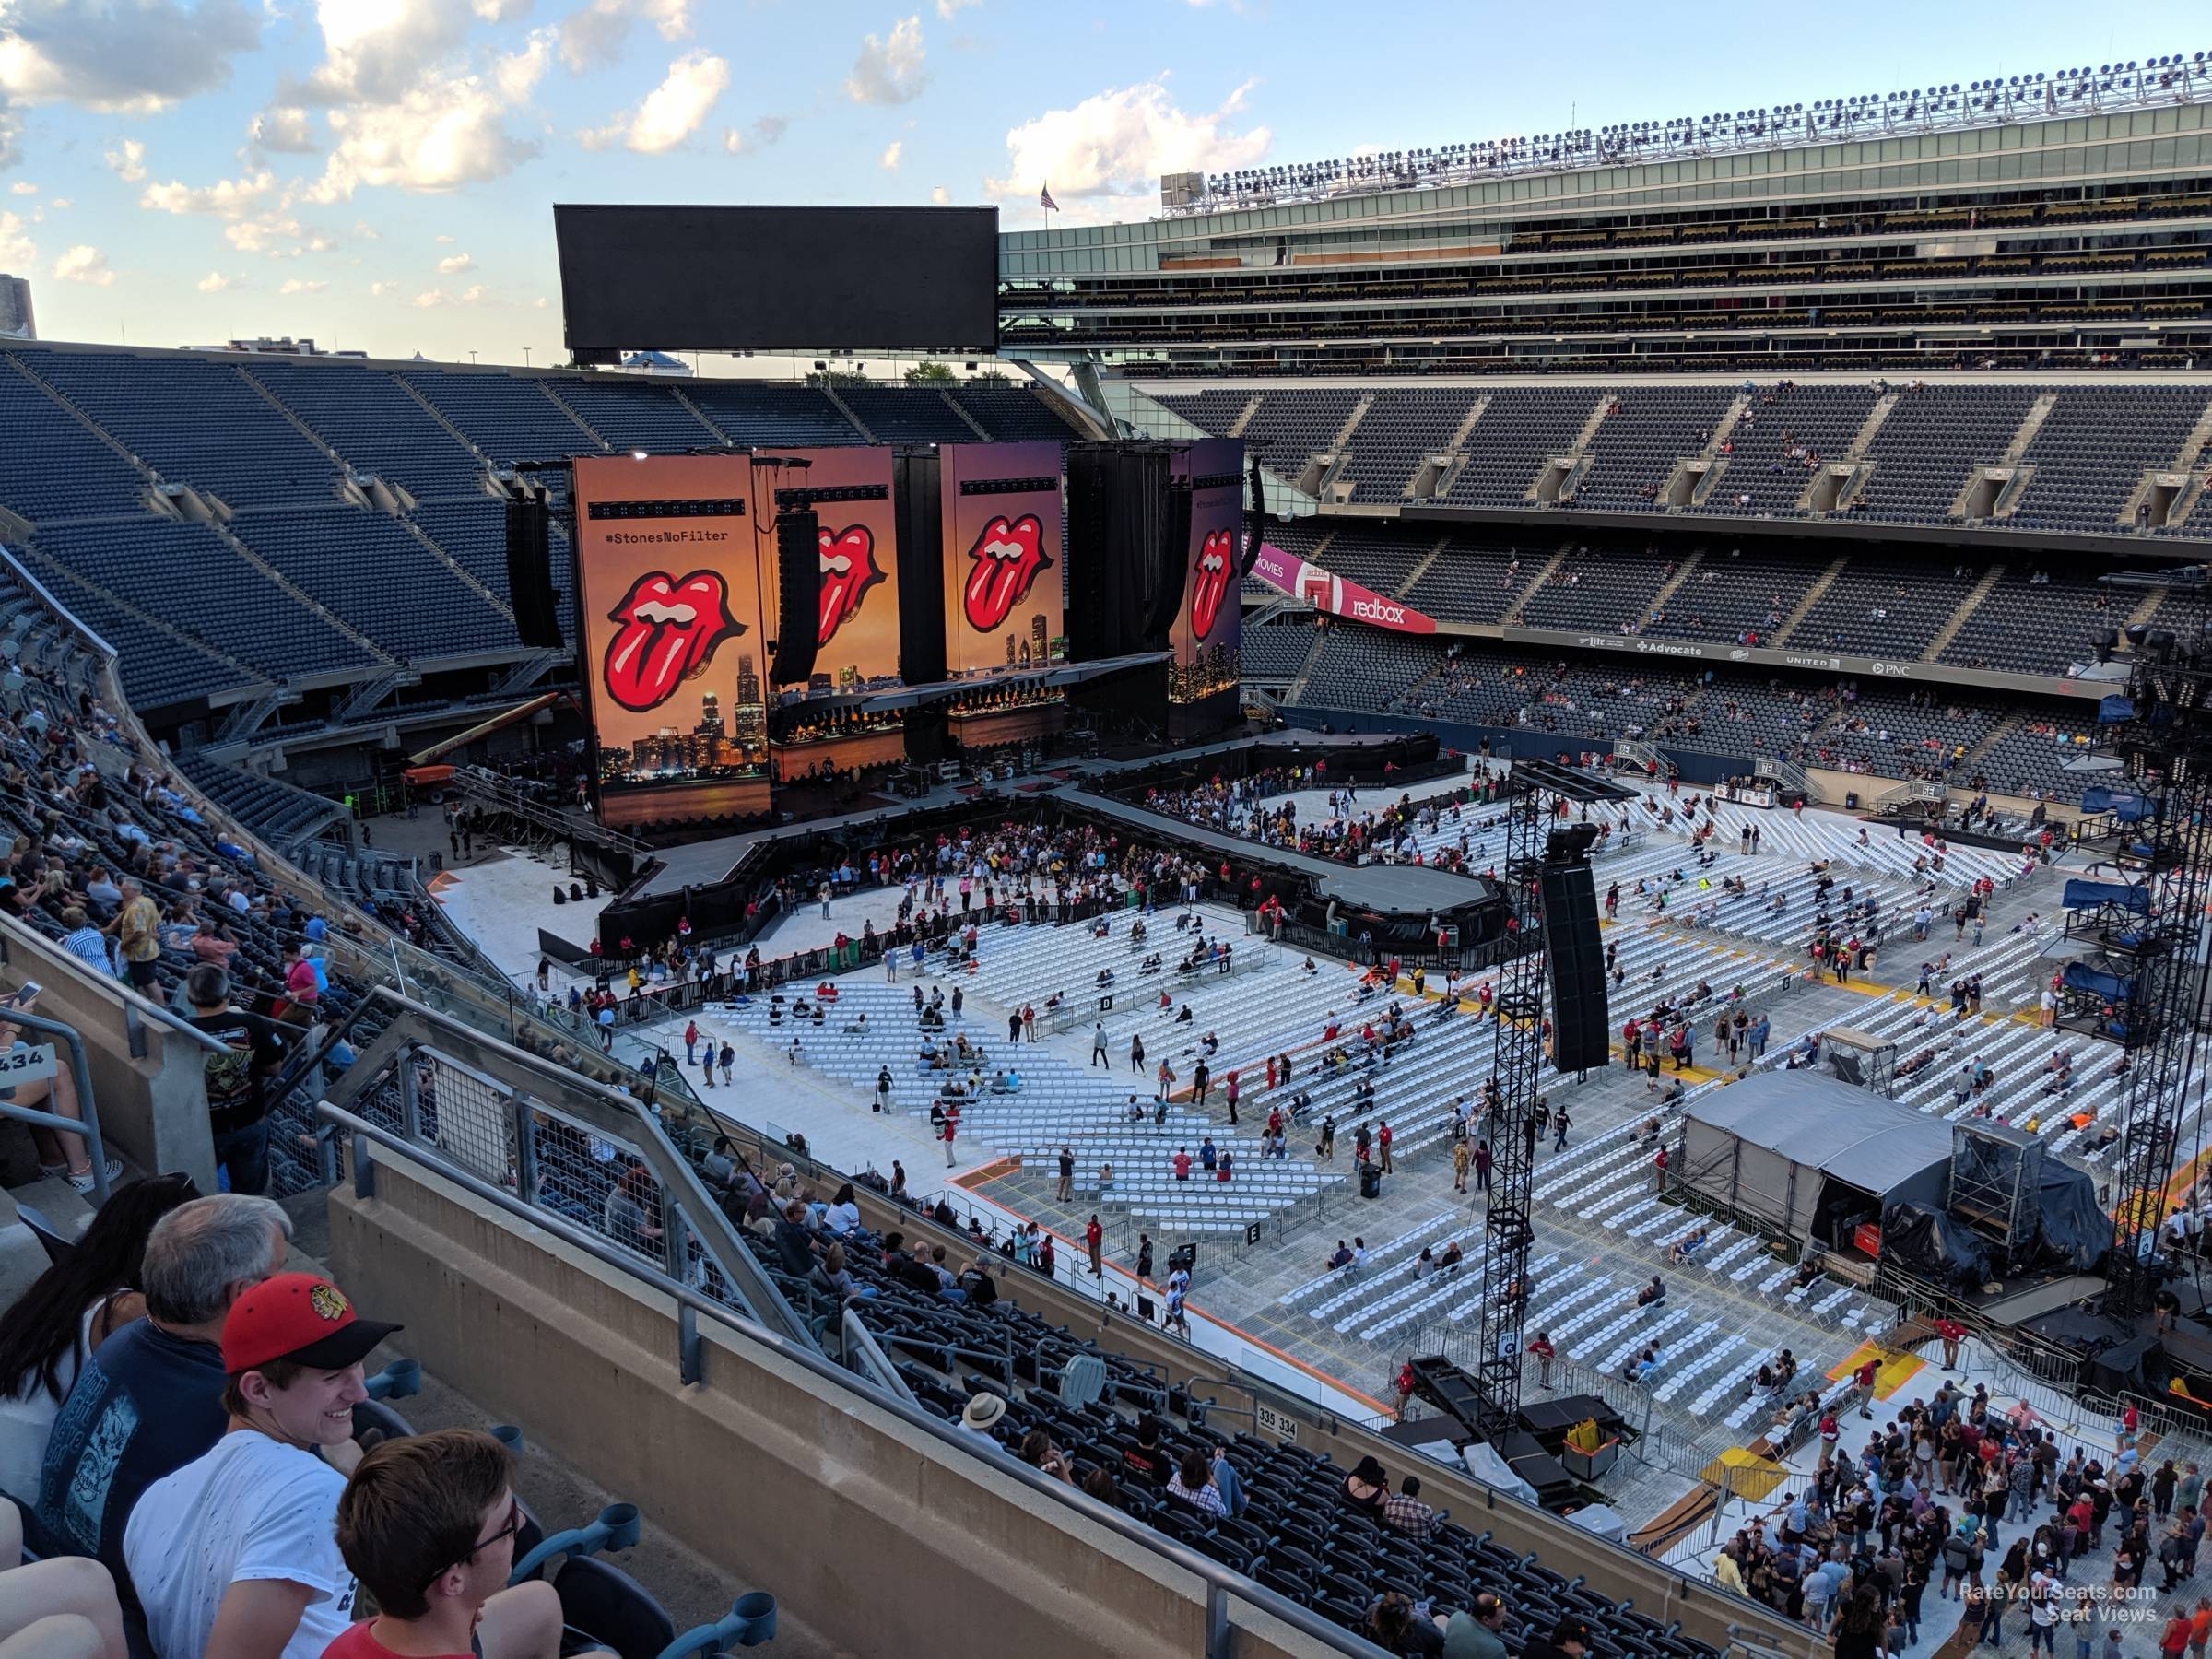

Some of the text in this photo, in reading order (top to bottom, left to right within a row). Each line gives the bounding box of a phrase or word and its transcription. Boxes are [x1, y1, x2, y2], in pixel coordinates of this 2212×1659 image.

[606, 531, 728, 544] #StonesNoFilter
[1353, 598, 1405, 624] redbox
[1648, 642, 1702, 656] Advocate
[1786, 656, 1827, 666] UNITED
[1885, 665, 1911, 677] PNC
[1923, 786, 1934, 796] 6E
[0, 1051, 44, 1072] 434
[1501, 1334, 1513, 1343] PIT
[1259, 1407, 1296, 1436] 335 334
